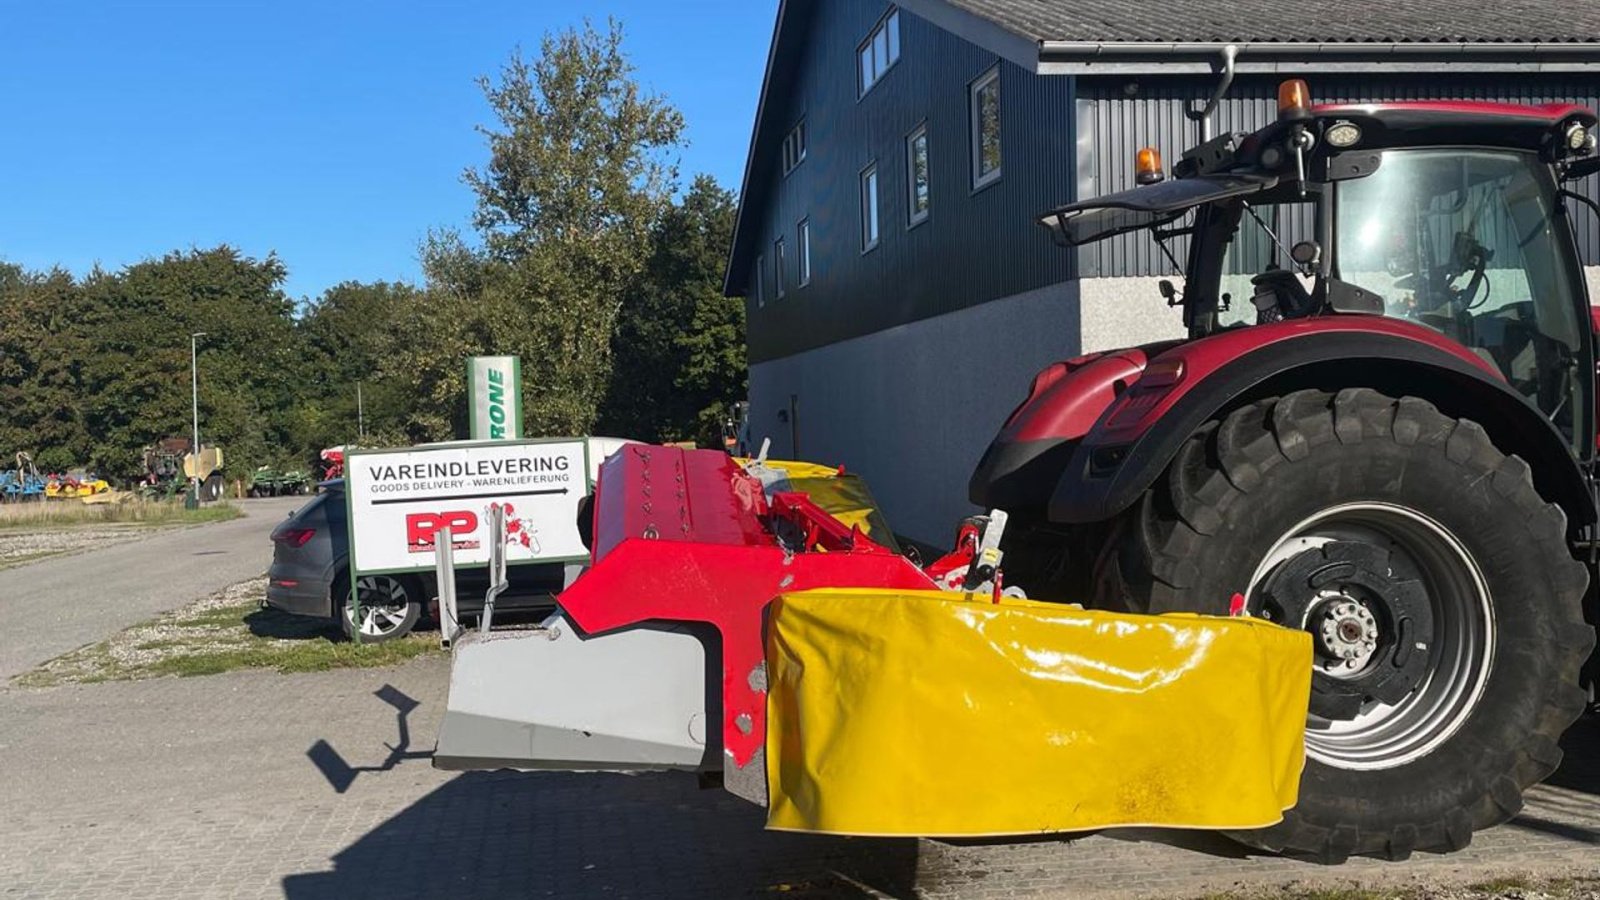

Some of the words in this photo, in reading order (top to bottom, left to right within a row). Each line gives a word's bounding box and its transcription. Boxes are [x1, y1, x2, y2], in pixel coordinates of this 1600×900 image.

[488, 368, 506, 440] RONE
[369, 455, 570, 481] VAREINDLEVERING
[370, 481, 410, 493] GOODS
[413, 479, 465, 491] DELIVERY
[473, 473, 570, 487] WARENLIEFERUNG
[406, 510, 479, 546] RP
